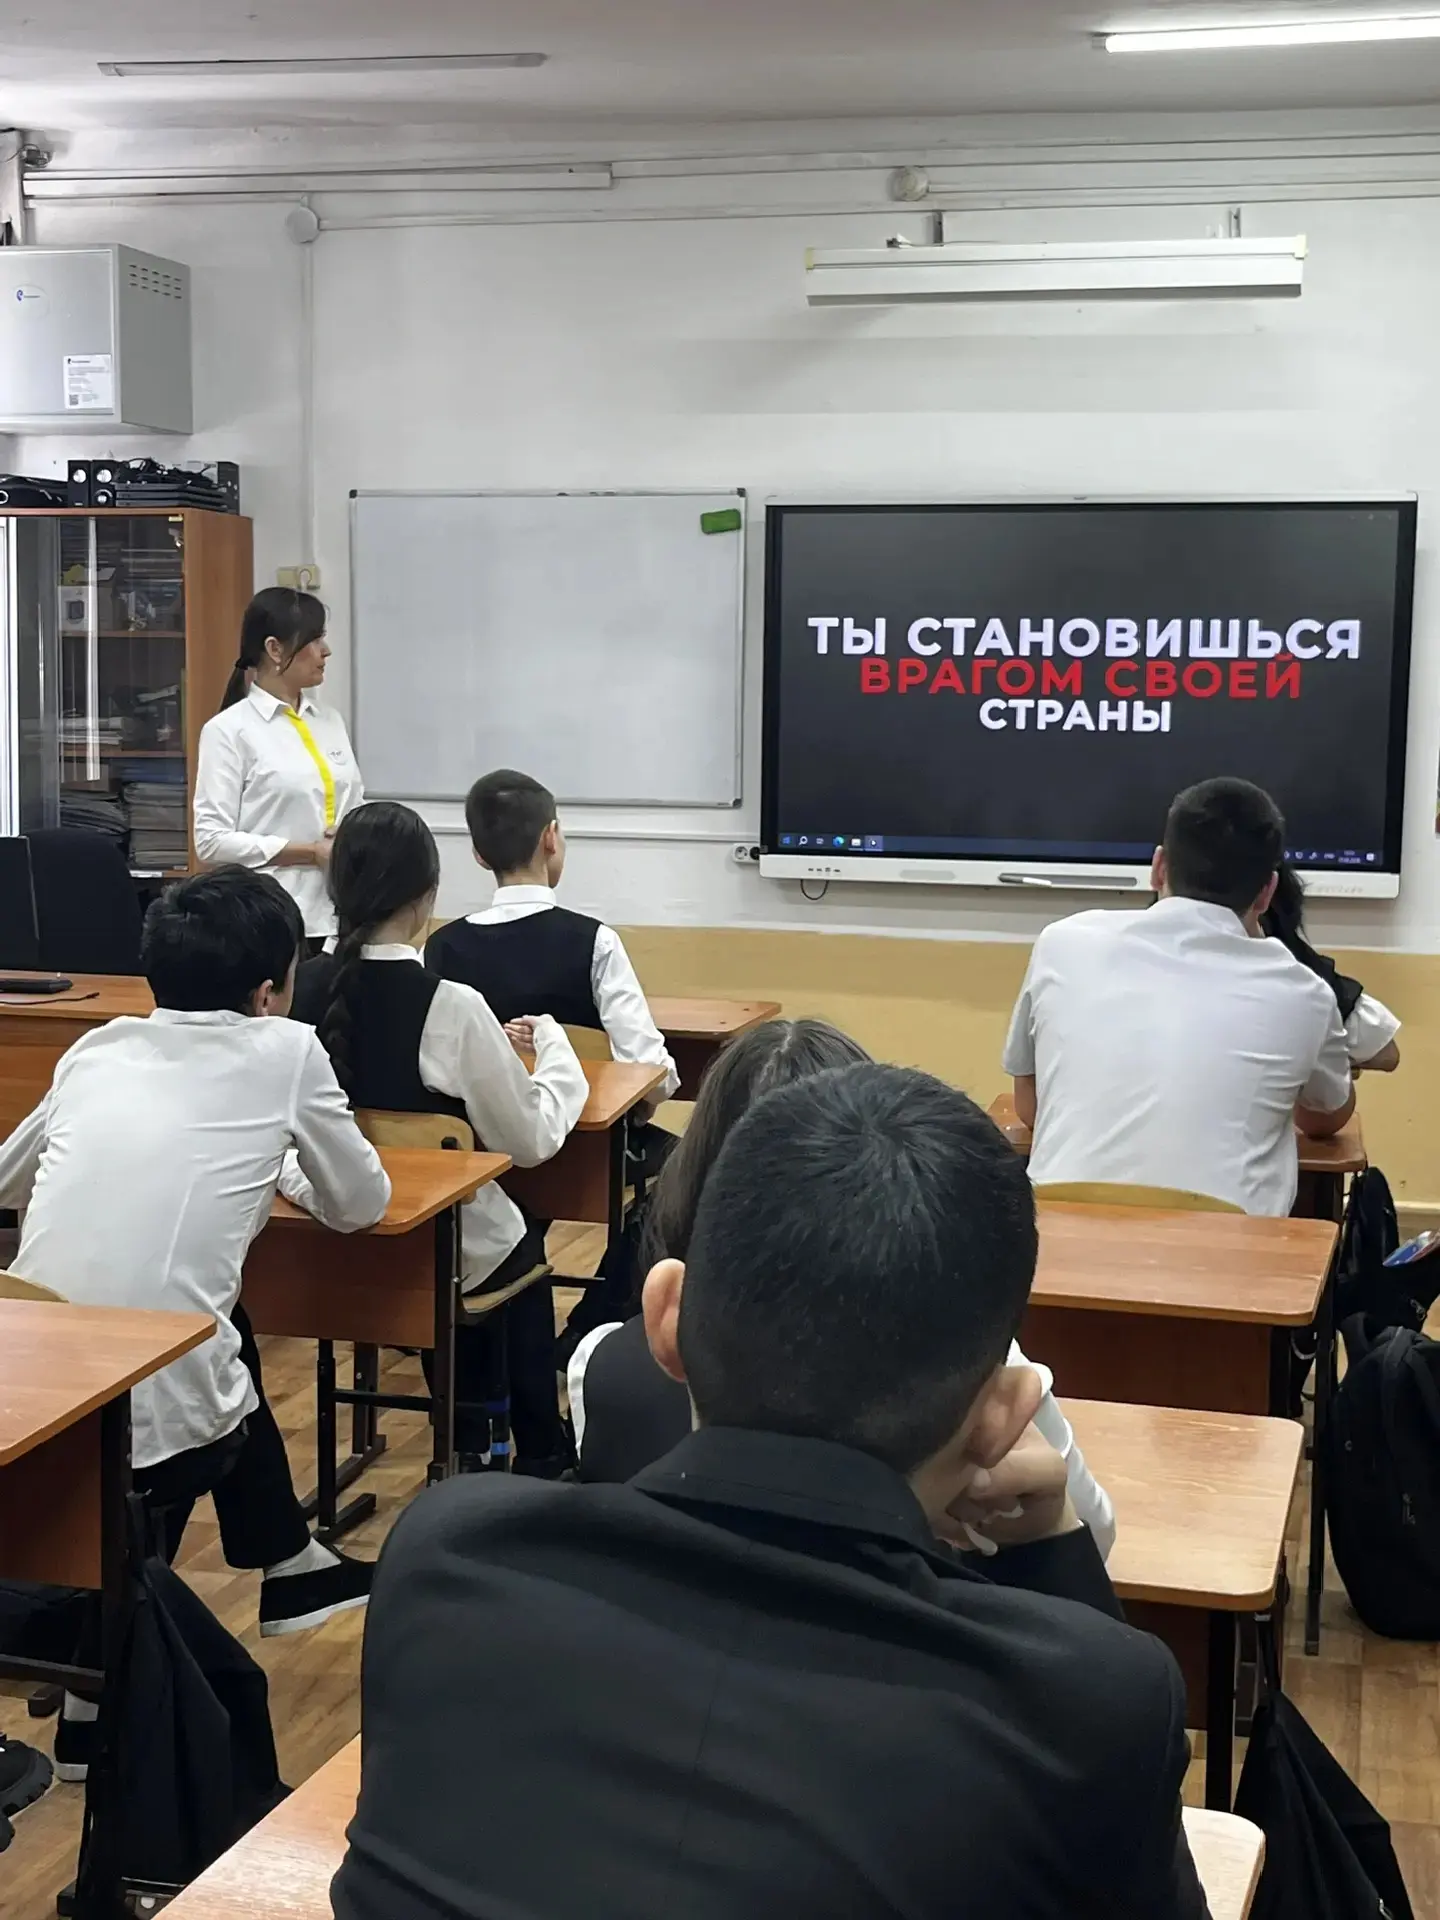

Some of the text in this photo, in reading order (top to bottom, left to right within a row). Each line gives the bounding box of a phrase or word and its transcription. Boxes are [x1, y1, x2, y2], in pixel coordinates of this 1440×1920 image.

[807, 616, 1361, 660] ТЫ СТАНОВИШЬСЯ
[860, 652, 1302, 699] ВРАГОМ СВОЕЙ
[979, 699, 1172, 733] СТРАНЫ
